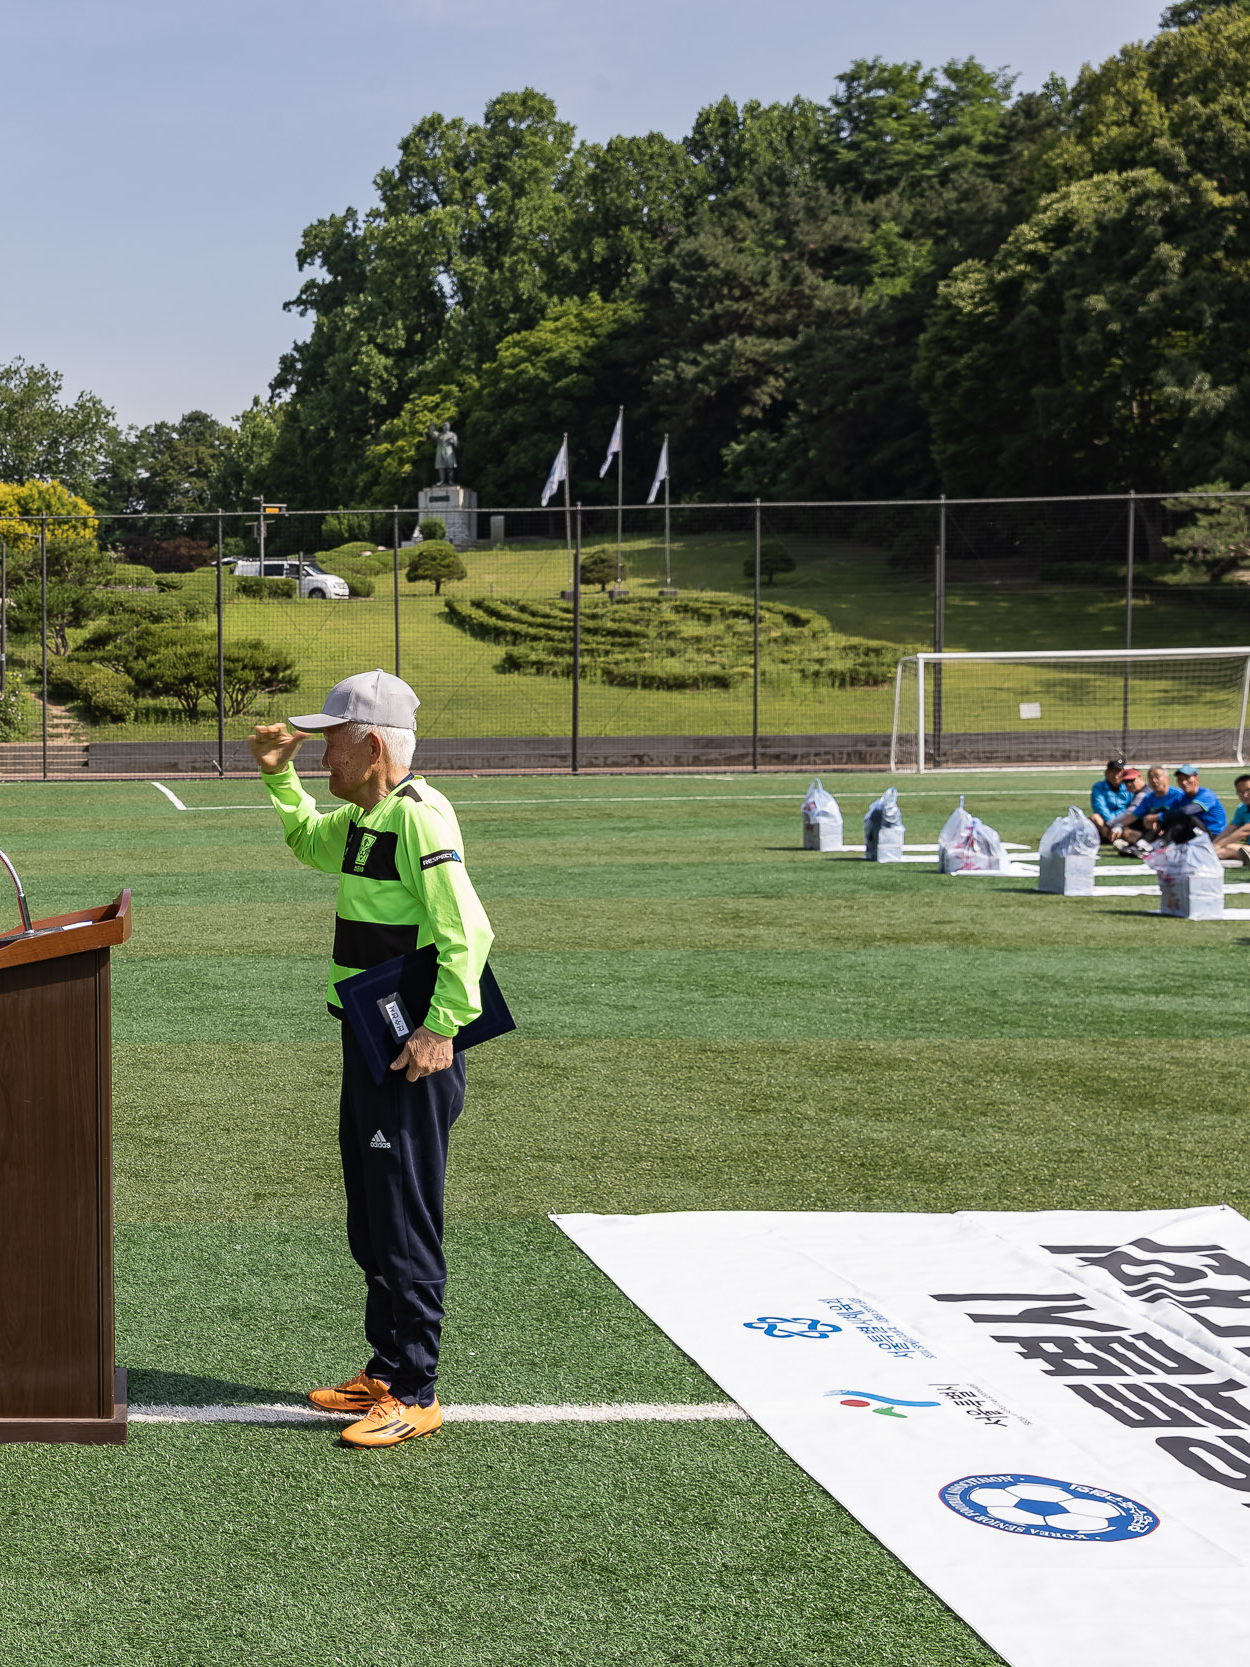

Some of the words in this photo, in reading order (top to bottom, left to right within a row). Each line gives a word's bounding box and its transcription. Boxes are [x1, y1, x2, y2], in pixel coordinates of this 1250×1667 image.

[422, 852, 453, 866] RESPECT
[388, 1005, 405, 1032] 선수선서
[369, 1141, 392, 1149] adidas
[817, 1297, 915, 1360] 서울특별시체육회
[928, 1383, 1008, 1428] 서울특별시
[1069, 1483, 1154, 1533] 한국장수축구협회
[976, 1514, 1025, 1534] SENIOR
[1030, 1529, 1090, 1540] KOREA
